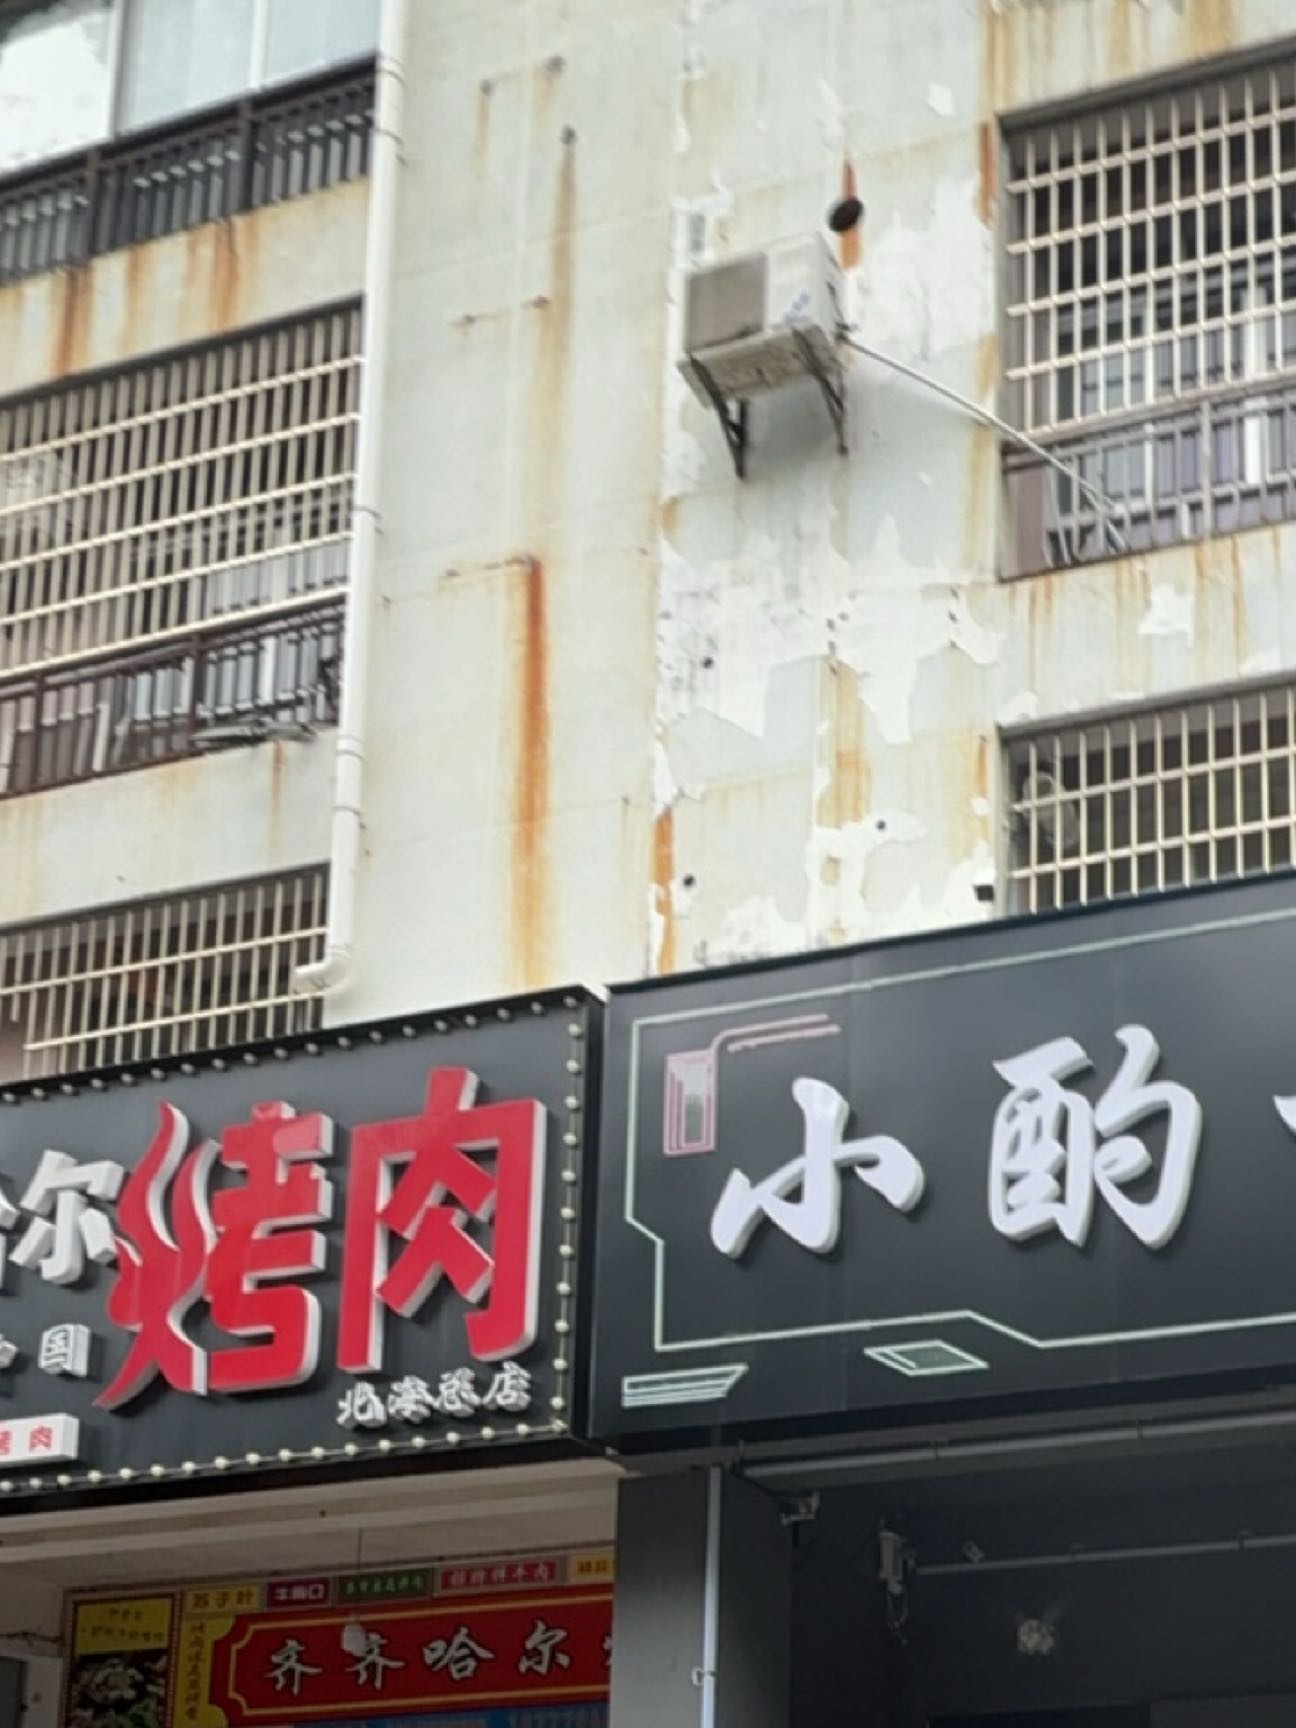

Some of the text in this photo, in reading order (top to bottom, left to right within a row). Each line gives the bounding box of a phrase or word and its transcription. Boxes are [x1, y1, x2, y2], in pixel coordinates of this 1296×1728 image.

[336, 1360, 533, 1430] 北海总店
[263, 1617, 612, 1698] 齐齐哈尔
